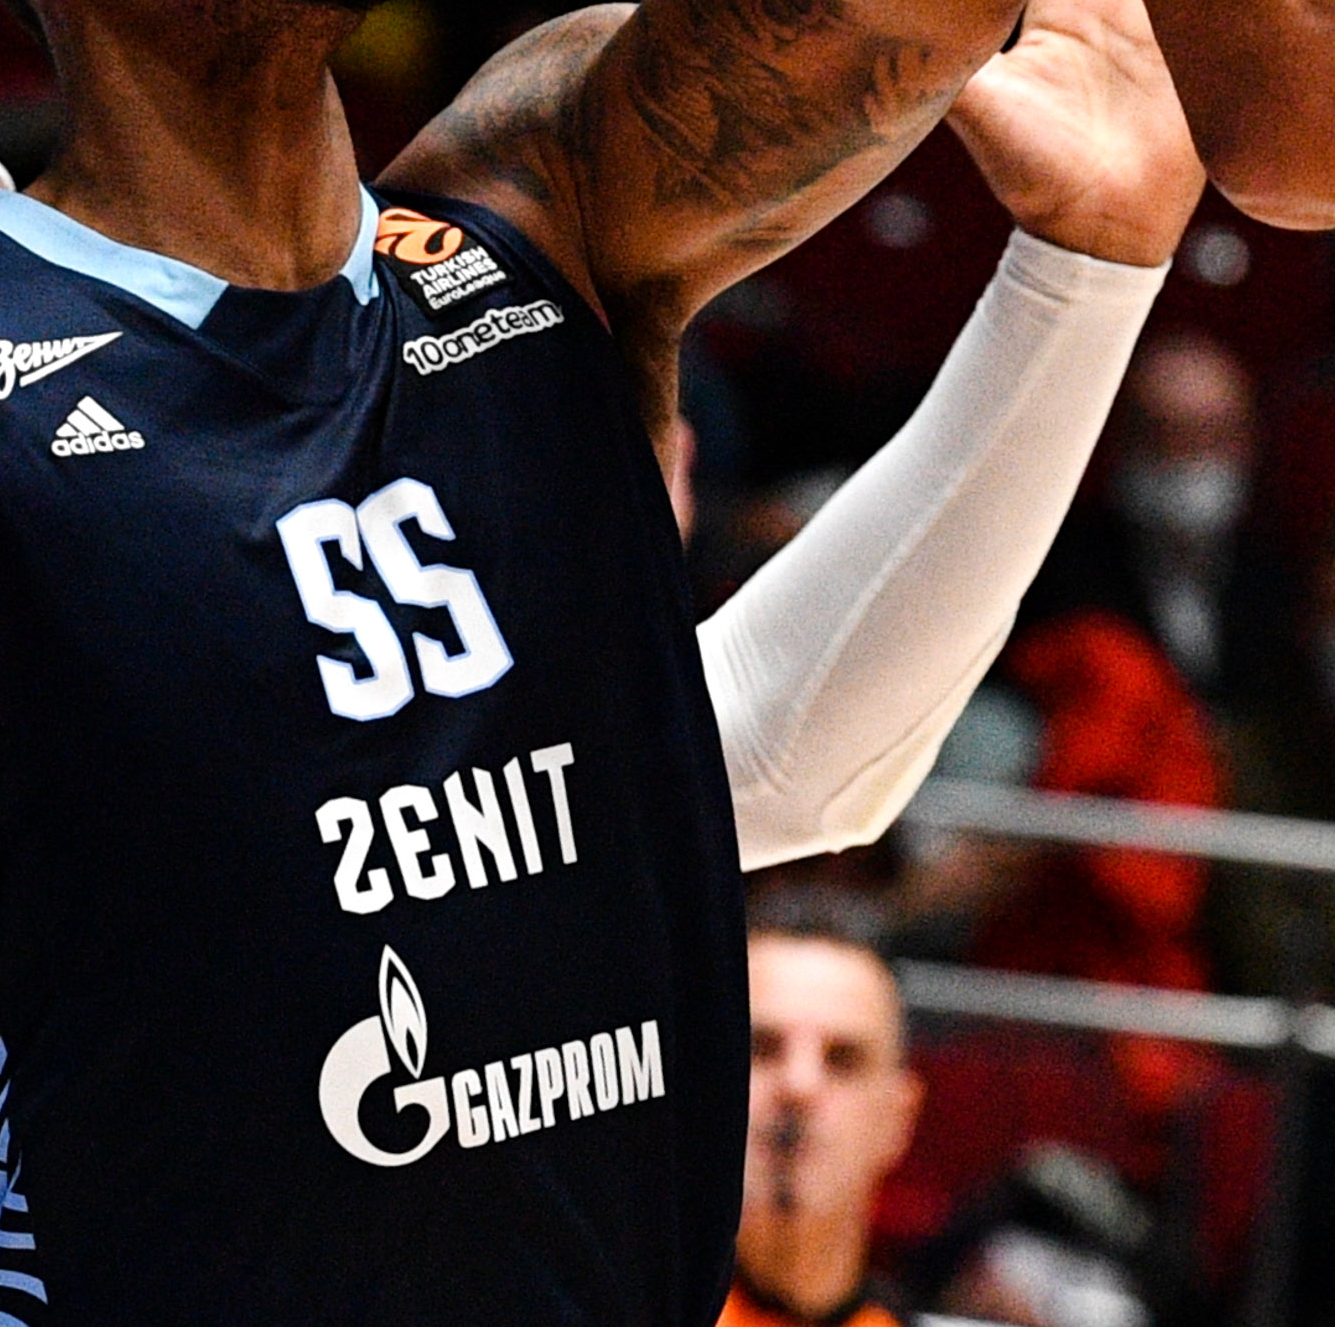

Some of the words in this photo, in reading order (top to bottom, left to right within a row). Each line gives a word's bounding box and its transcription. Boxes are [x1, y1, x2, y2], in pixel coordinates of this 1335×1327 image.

[410, 246, 490, 286] TURKISH
[422, 259, 499, 300] AIRLINES
[51, 430, 145, 457] adidas
[315, 742, 577, 915] ZENIT
[451, 1019, 665, 1149] GAZPROM
